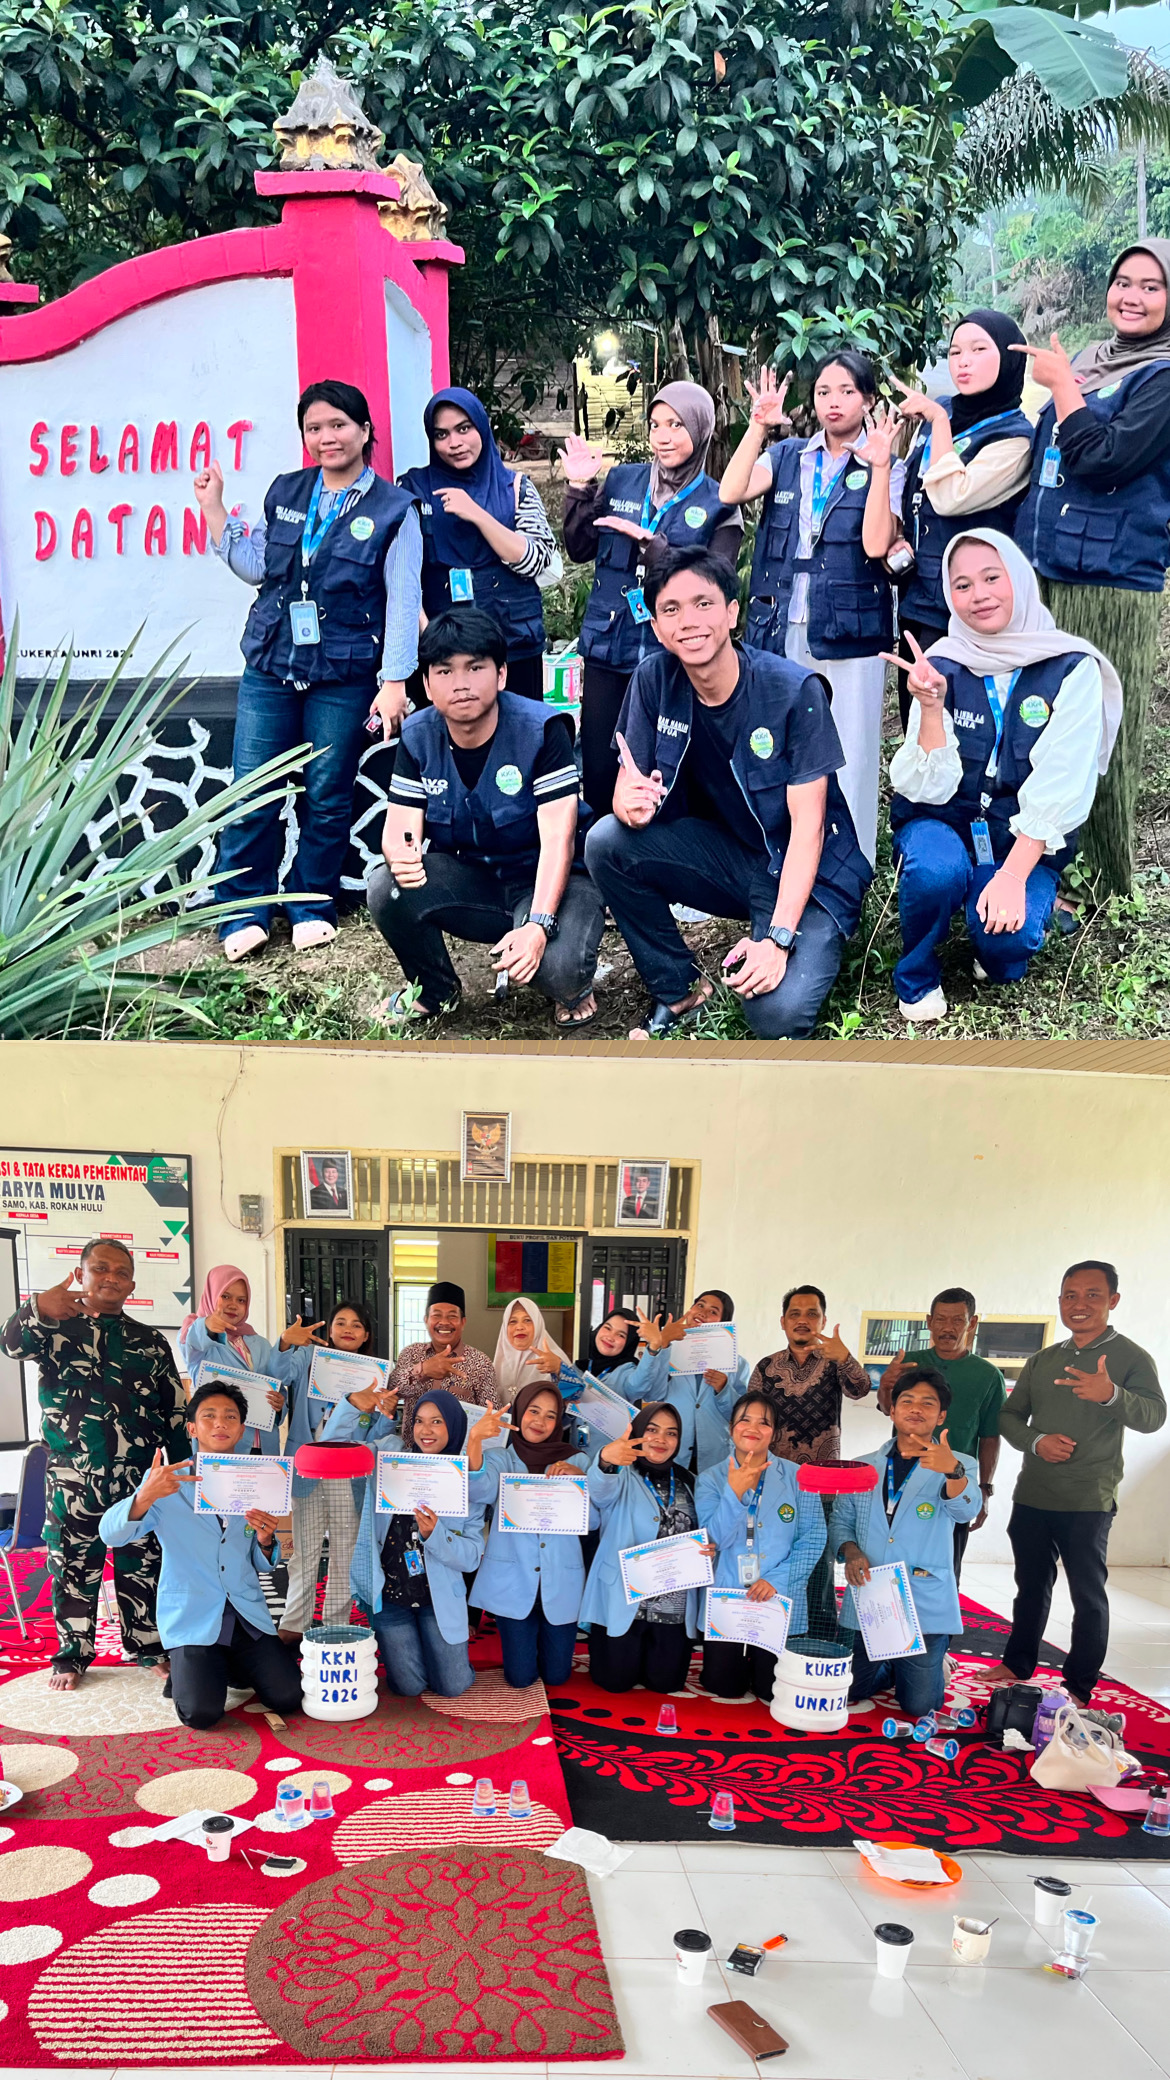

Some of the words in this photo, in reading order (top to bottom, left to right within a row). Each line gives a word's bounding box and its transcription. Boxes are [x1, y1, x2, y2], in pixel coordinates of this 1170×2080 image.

[29, 420, 253, 477] SELAMAT
[17, 649, 69, 659] UKERTA
[73, 649, 102, 658] UNRI
[106, 649, 133, 658] 202
[0, 1161, 11, 1177] SI
[13, 1161, 21, 1177] &
[22, 1162, 46, 1178] TATA
[47, 1163, 81, 1179] KERJA
[83, 1165, 147, 1182] PEMERINTAH
[0, 1180, 45, 1198] ARYA
[49, 1182, 106, 1201] MULYA
[2, 1199, 28, 1210] SAMO,
[29, 1200, 48, 1210] KAB.
[50, 1201, 79, 1211] ROKAN
[81, 1203, 103, 1212] HULU
[321, 1650, 356, 1665] KKN
[320, 1669, 358, 1683] UNRI
[321, 1688, 358, 1703] 2026
[795, 1694, 835, 1712] UNRI
